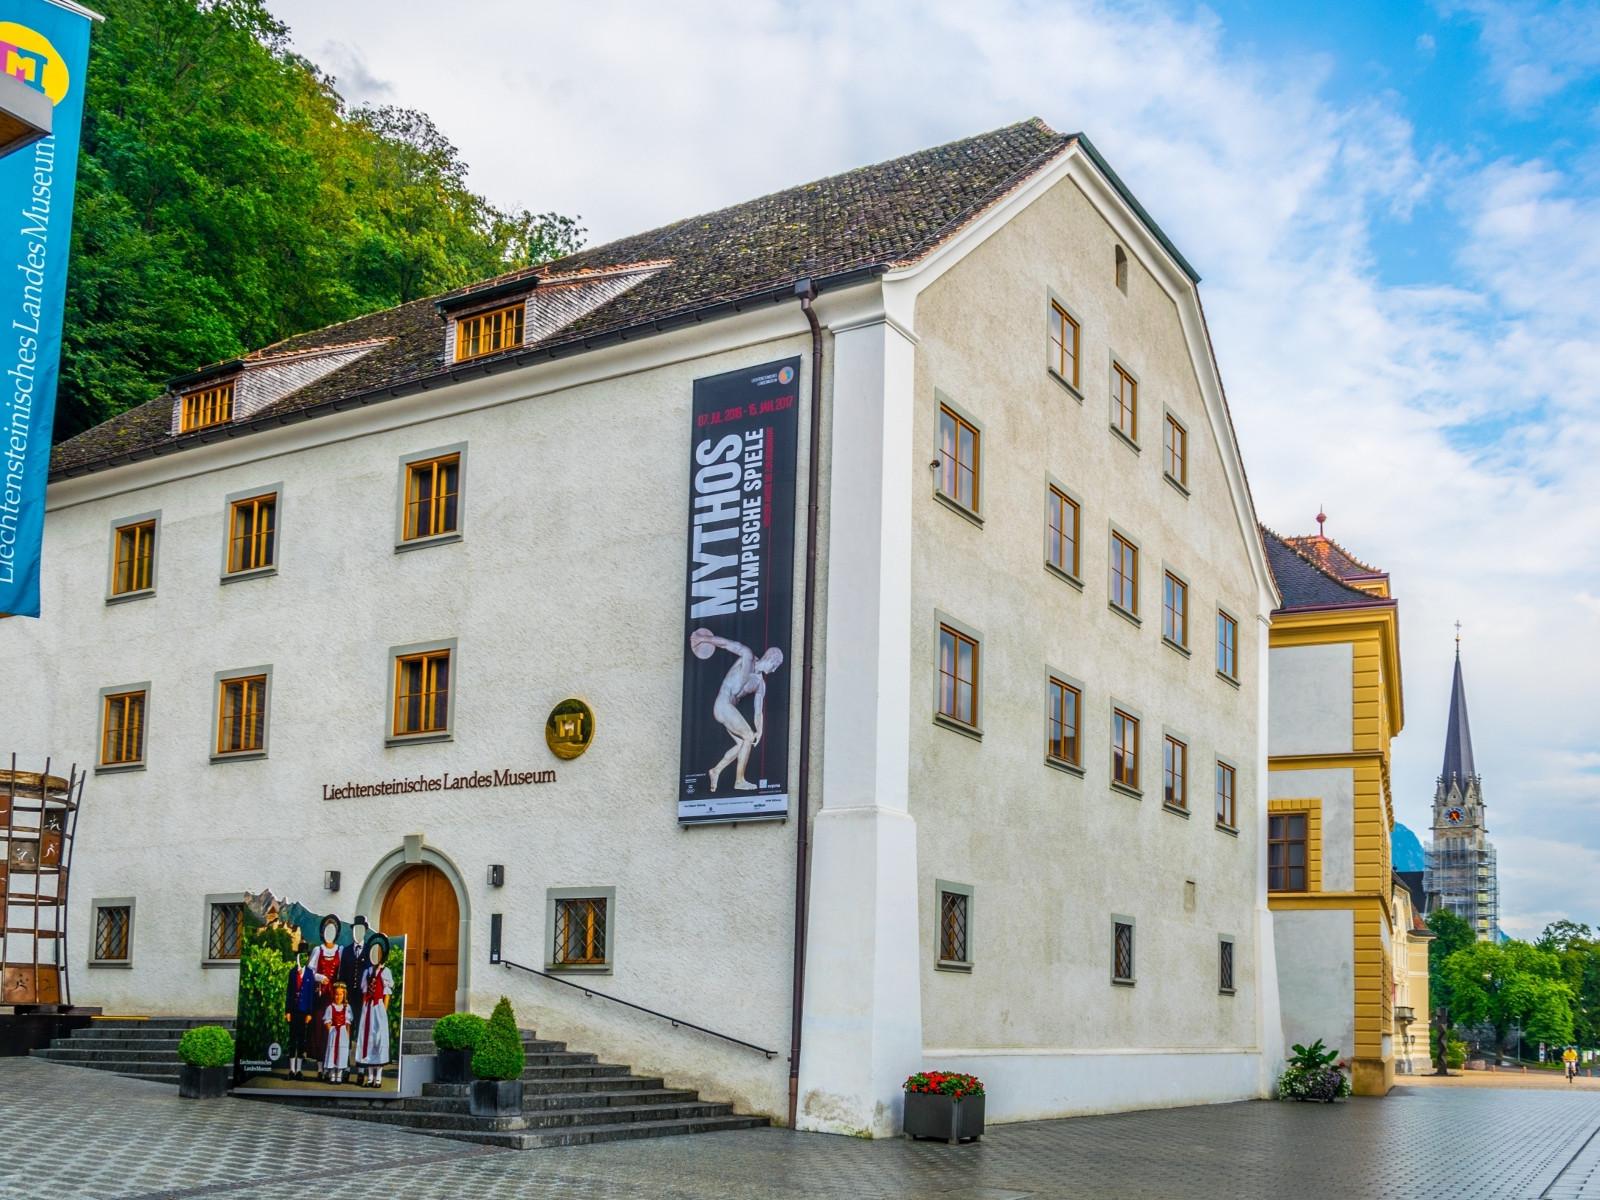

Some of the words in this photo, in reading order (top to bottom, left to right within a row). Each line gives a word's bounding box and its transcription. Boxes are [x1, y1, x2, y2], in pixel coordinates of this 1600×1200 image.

[743, 428, 764, 490] SPIELE
[691, 434, 743, 619] MYTHOS
[739, 495, 762, 612] OLYMPISCHE
[322, 775, 442, 801] Liechtensteinisches
